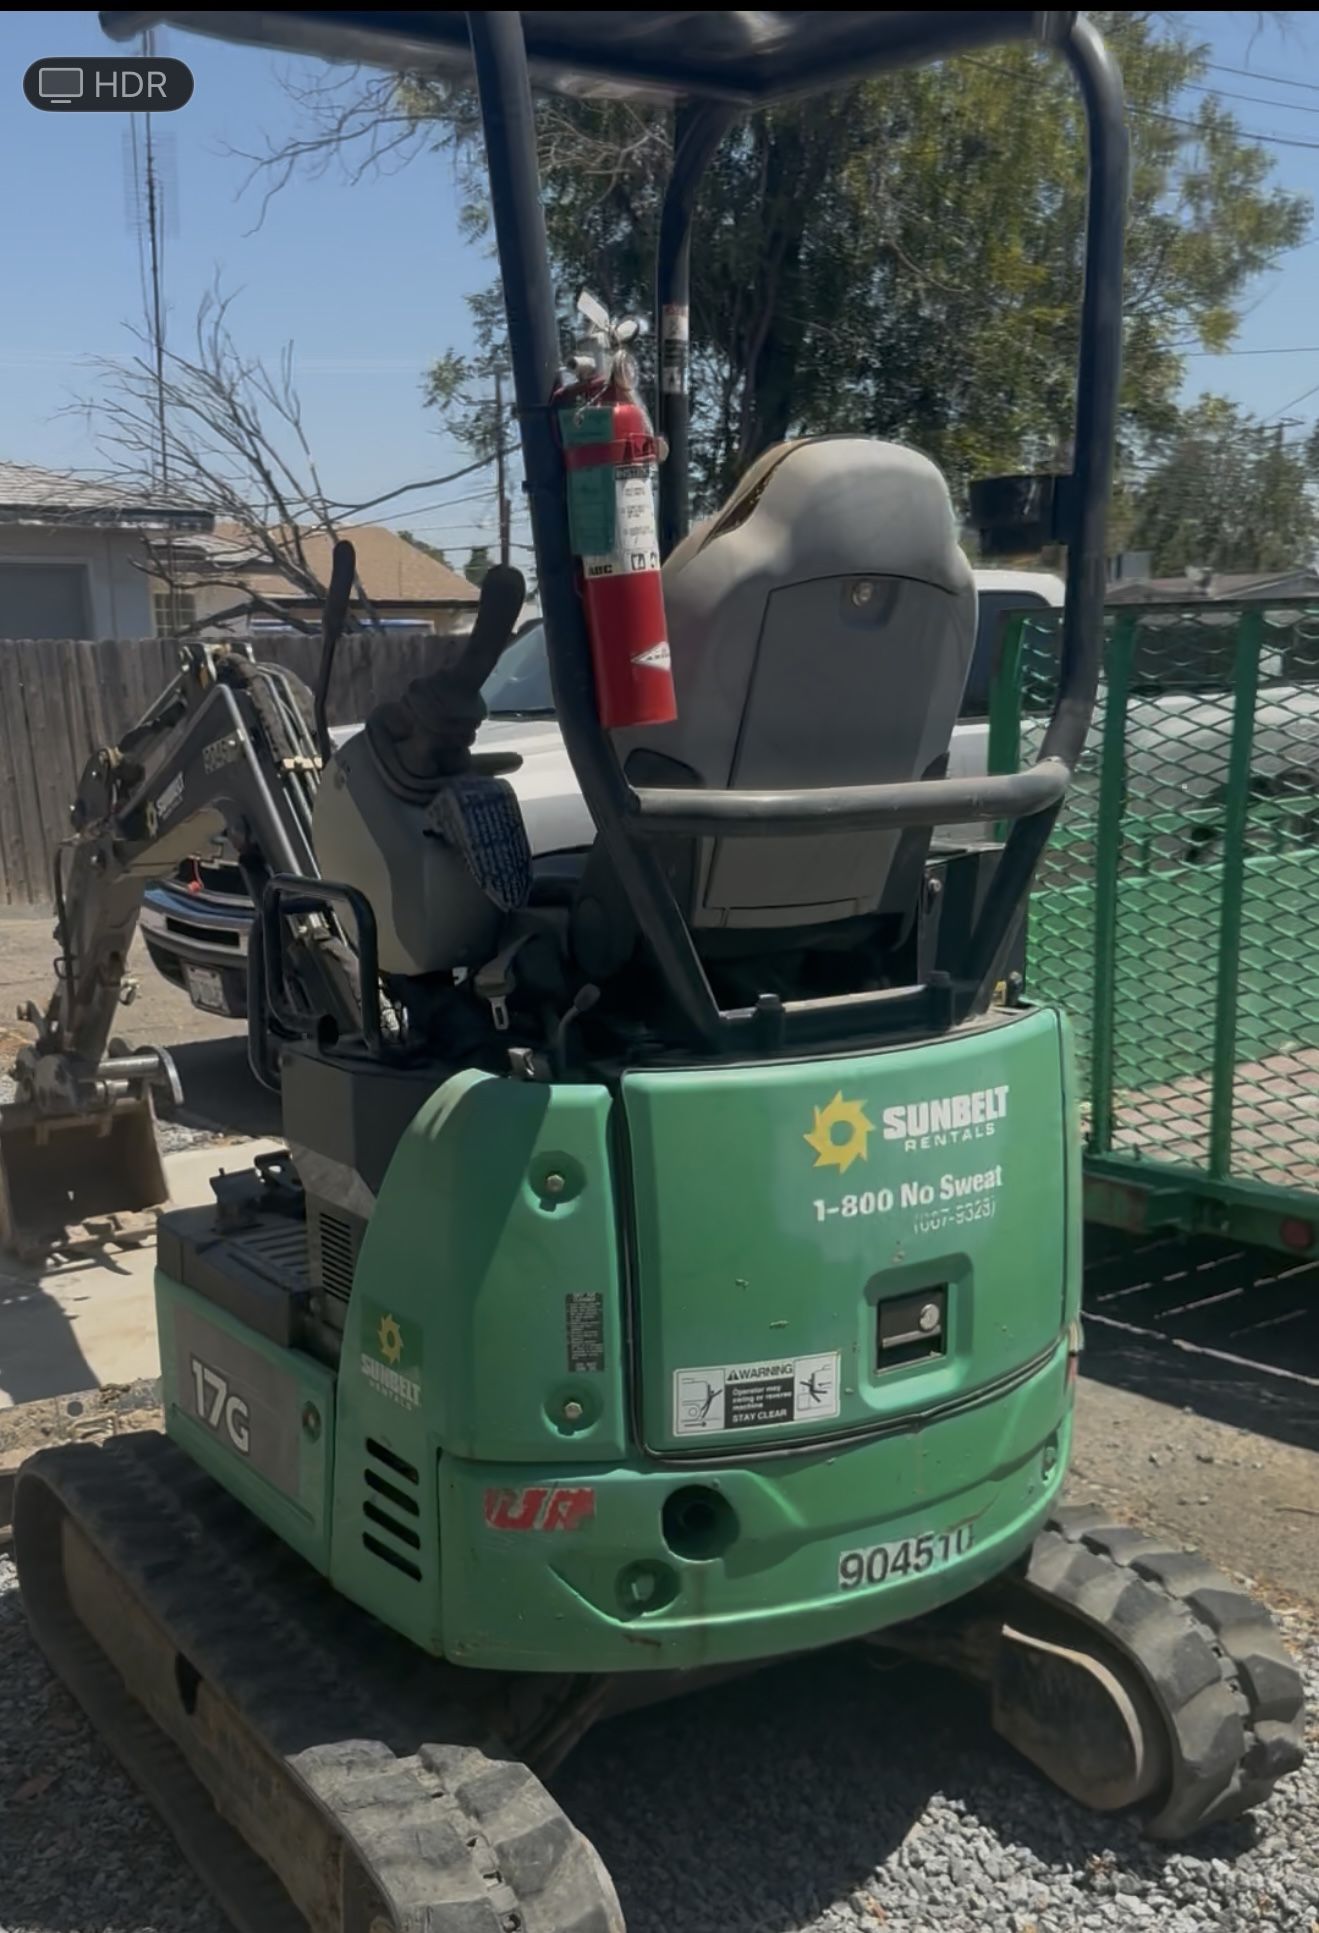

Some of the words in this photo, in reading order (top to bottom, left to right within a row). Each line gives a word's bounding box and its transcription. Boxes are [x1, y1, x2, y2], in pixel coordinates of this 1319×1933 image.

[882, 1085, 1010, 1140] SUNBELT
[904, 1122, 996, 1152] RENTALS
[812, 1188, 894, 1222] 1-800
[901, 1181, 935, 1209] No
[940, 1165, 1003, 1200] Sweat
[361, 1352, 421, 1408] SUNBELT
[739, 1363, 793, 1379] WARNING
[190, 1355, 250, 1454] 17G
[733, 1413, 755, 1422] STAY
[757, 1408, 787, 1420] CLEAR
